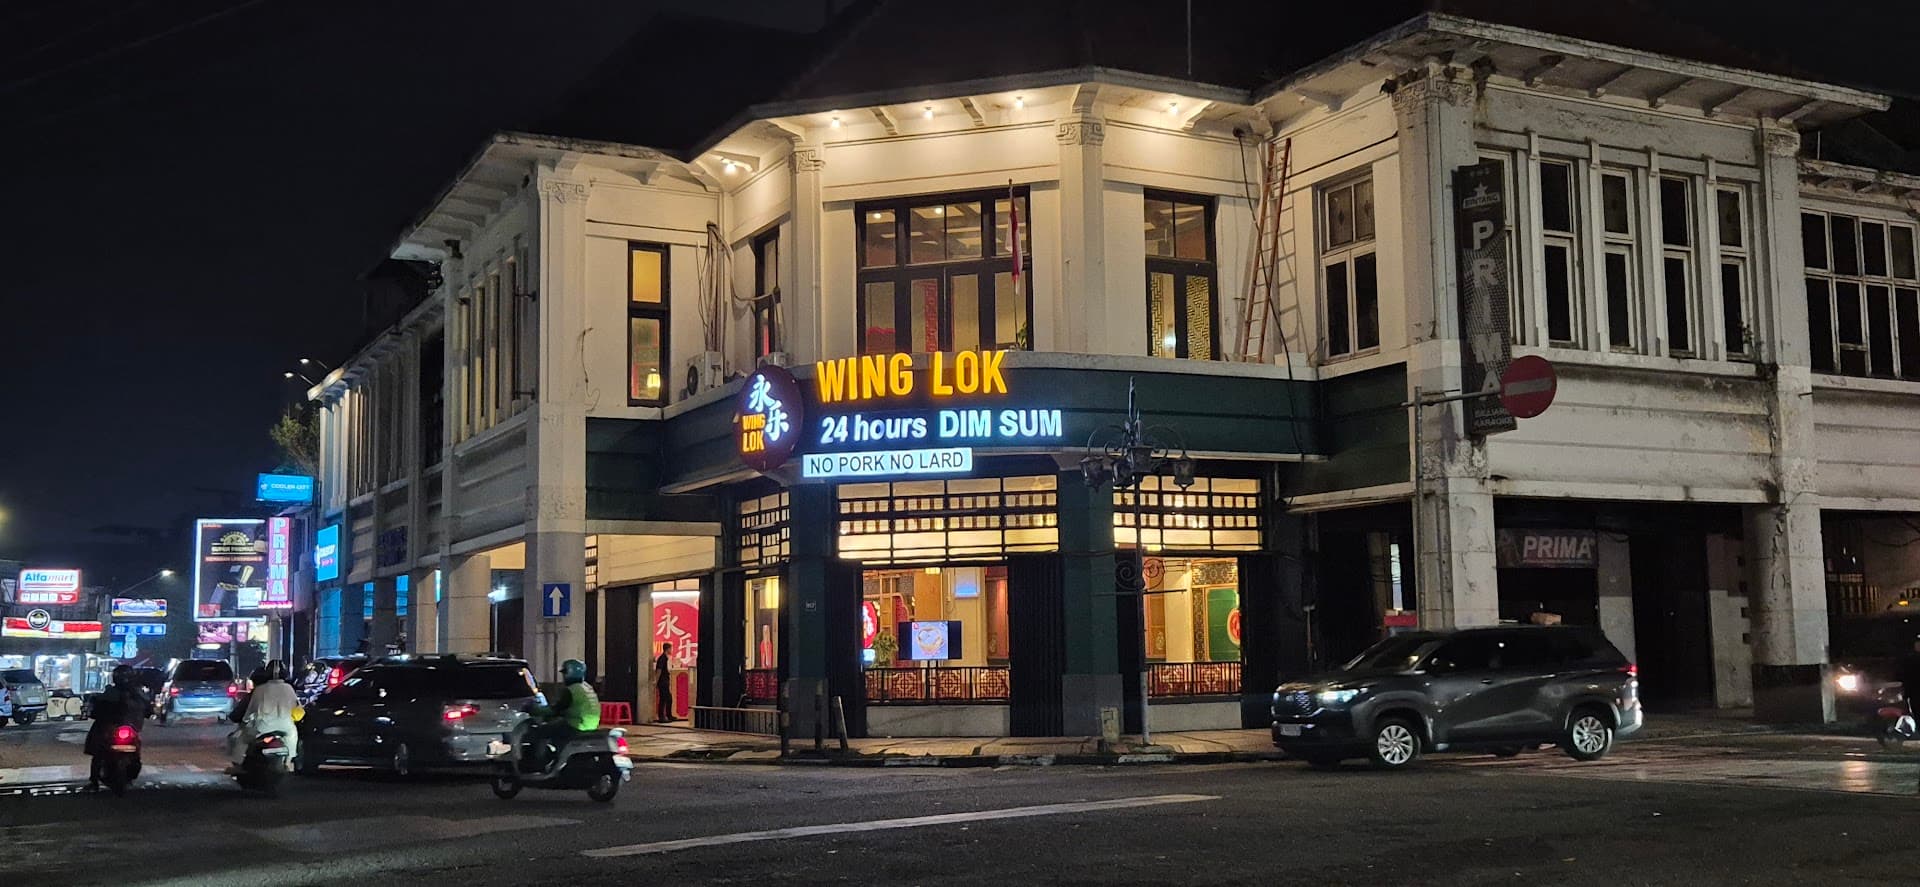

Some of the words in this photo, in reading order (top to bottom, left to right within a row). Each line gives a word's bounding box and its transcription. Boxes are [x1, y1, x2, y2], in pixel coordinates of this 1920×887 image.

[1471, 219, 1501, 400] PRIMA
[817, 352, 914, 403] WING
[932, 350, 1008, 396] LOK
[742, 413, 766, 430] WING
[749, 374, 790, 442] 永乐
[820, 415, 848, 444] 24
[854, 413, 928, 441] hours
[939, 409, 992, 438] DIM
[999, 409, 1063, 438] SUM
[742, 430, 765, 453] LOK
[810, 456, 834, 474] NO
[839, 454, 884, 472] PORK
[890, 453, 914, 471] NO
[919, 451, 964, 470] LARD
[271, 519, 288, 595] PRIMA
[1522, 535, 1592, 559] PRIMA
[24, 573, 74, 582] Alfamart
